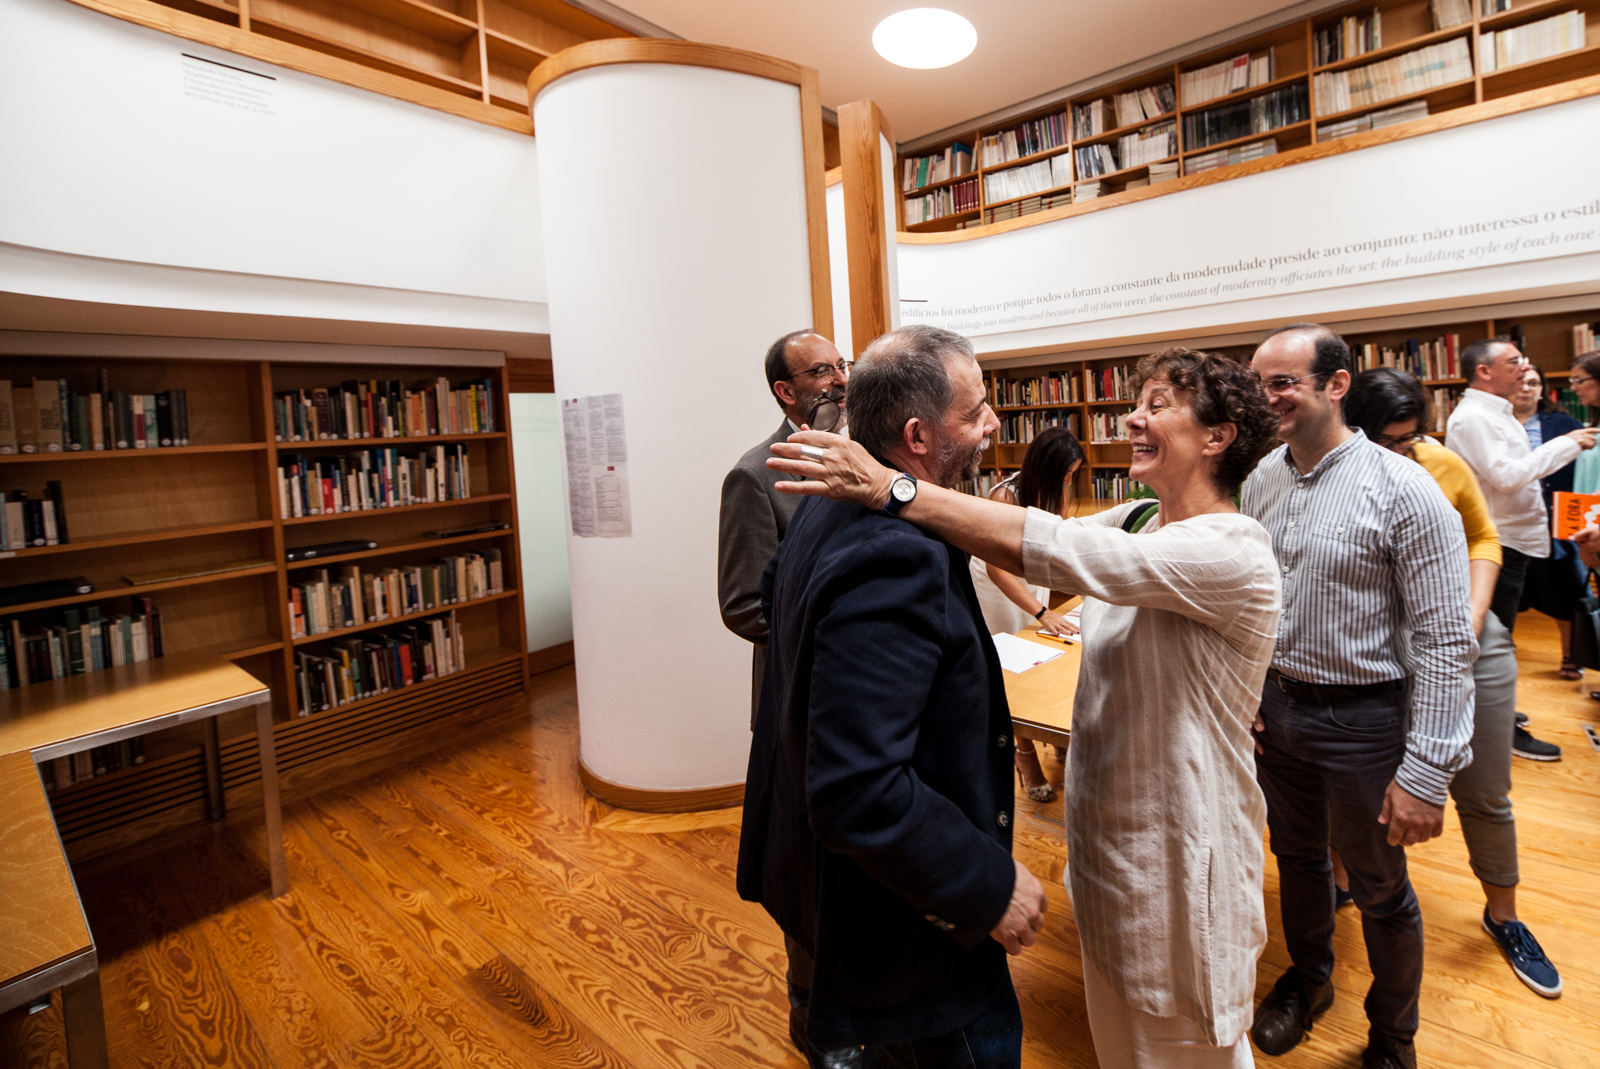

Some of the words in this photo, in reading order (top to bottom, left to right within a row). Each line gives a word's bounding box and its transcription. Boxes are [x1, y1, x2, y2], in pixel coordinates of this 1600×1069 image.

[941, 307, 953, 317] foi
[955, 304, 995, 316] moderno
[996, 302, 1001, 310] e
[1003, 297, 1035, 312] porque
[1036, 292, 1062, 304] todos
[1063, 291, 1070, 300] o
[1072, 287, 1101, 299] foram
[1103, 285, 1109, 294] a
[1111, 275, 1163, 292] constante
[1166, 271, 1180, 283] da
[1182, 257, 1266, 281] modernidade
[1269, 247, 1320, 270] preside
[1323, 246, 1341, 258] ao
[1344, 234, 1418, 254] conjunto;
[1422, 227, 1454, 242] não
[1458, 213, 1538, 236] interessa
[1543, 210, 1556, 222] o
[947, 320, 981, 331] buildings
[983, 319, 997, 327] was
[999, 314, 1027, 324] modern
[1028, 310, 1044, 320] and
[1045, 307, 1077, 318] because
[1077, 303, 1089, 314] all
[1090, 301, 1100, 314] of
[1100, 300, 1122, 311] them
[1149, 292, 1164, 303] the
[1165, 286, 1208, 301] constant
[1209, 282, 1222, 297] of
[1221, 276, 1279, 292] modernity
[1280, 268, 1334, 287] officiates
[1336, 263, 1355, 276] the
[1381, 257, 1402, 269] the
[1405, 248, 1465, 266] building
[1467, 241, 1501, 259] style
[1503, 236, 1522, 254] of
[1522, 231, 1560, 249] each
[1563, 229, 1596, 243] one
[1567, 498, 1581, 522] FORA
